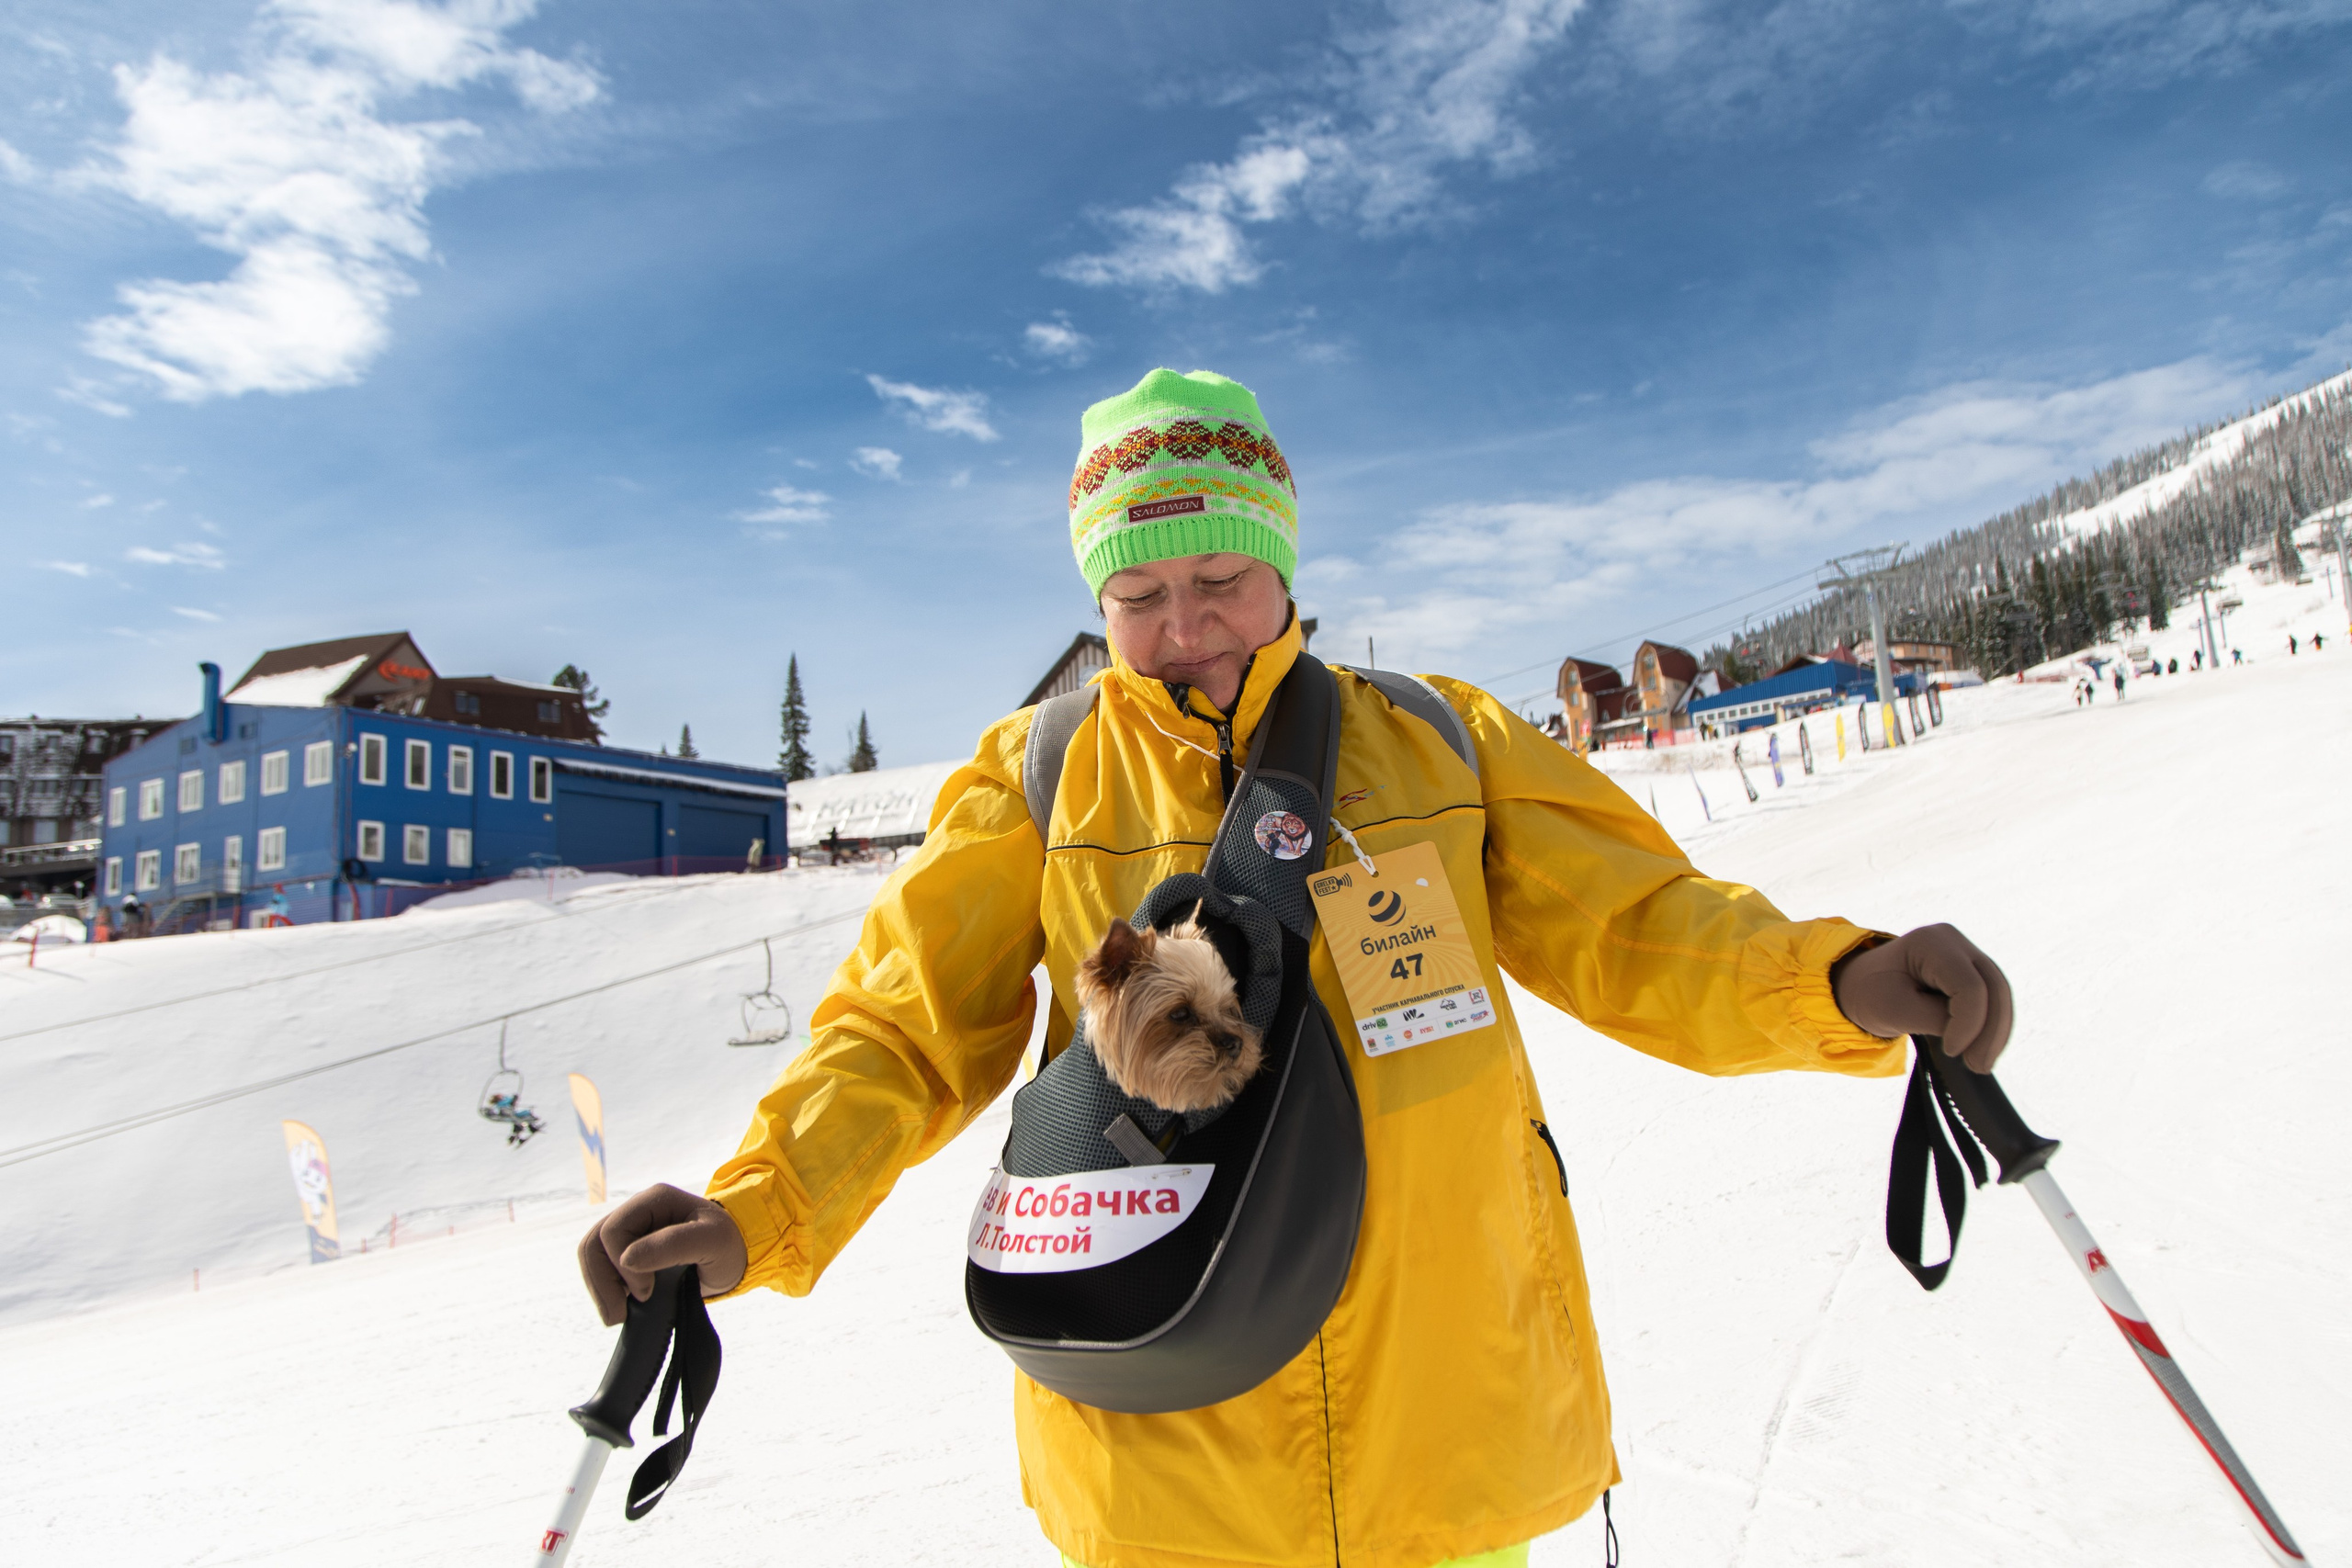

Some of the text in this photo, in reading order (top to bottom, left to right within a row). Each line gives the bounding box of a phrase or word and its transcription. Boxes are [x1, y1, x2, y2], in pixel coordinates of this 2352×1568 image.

[1132, 501, 1199, 519] SALOMON
[1319, 886, 1331, 895] FEST
[1361, 925, 1437, 955] билайн
[1390, 953, 1424, 980] 47
[1372, 984, 1465, 1015] УЧАСТНИК КАРНАВАЛЬНОГО СПУСКА
[1015, 1184, 1181, 1218] Собачка
[976, 1223, 1092, 1255] Л.Толстой
